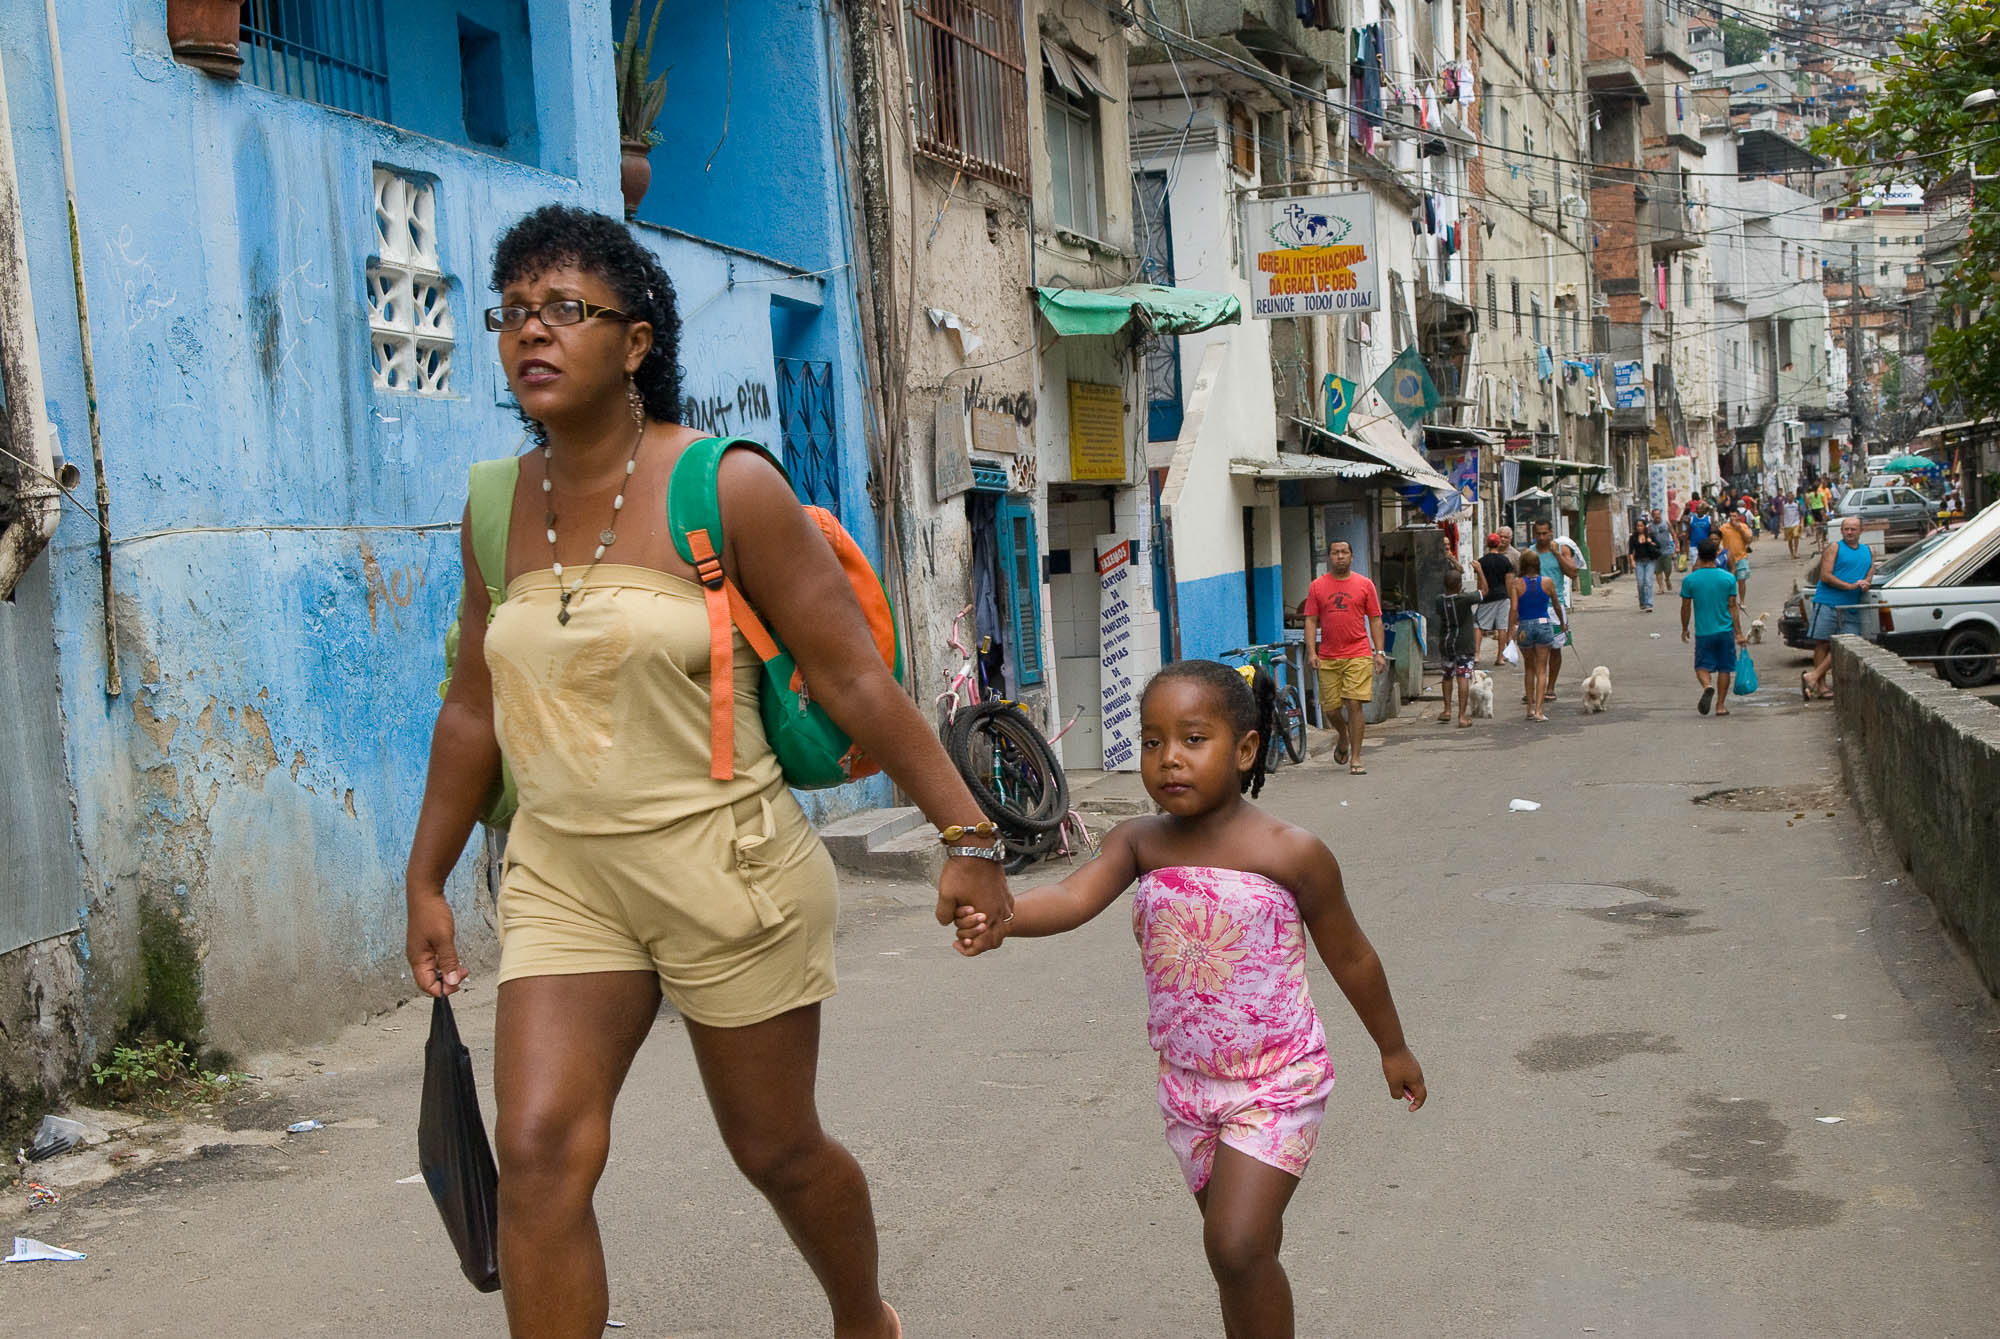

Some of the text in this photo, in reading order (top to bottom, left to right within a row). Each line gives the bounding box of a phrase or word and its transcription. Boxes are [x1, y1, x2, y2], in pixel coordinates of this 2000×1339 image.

[1258, 245, 1367, 274] IGREJA INTERNACIONAL
[1269, 278, 1282, 296] DA
[1317, 275, 1330, 292] DE
[1332, 272, 1357, 292] DEUS
[1304, 294, 1334, 311] TODOS
[1336, 293, 1348, 309] OS
[1350, 291, 1372, 308] DIAS
[1100, 546, 1127, 571] FAZEMOS
[1110, 589, 1120, 600] DE
[1101, 599, 1129, 620] VISITA
[1101, 614, 1131, 636] PANFLETOS
[1111, 667, 1121, 678] DE
[1102, 686, 1115, 699] DVD
[1119, 676, 1132, 689] DVD
[1103, 707, 1132, 730] ESTAMPAS
[1112, 729, 1123, 740] EM
[1104, 737, 1132, 759] CAMISAS
[1104, 749, 1133, 771] SILK SCREEN
